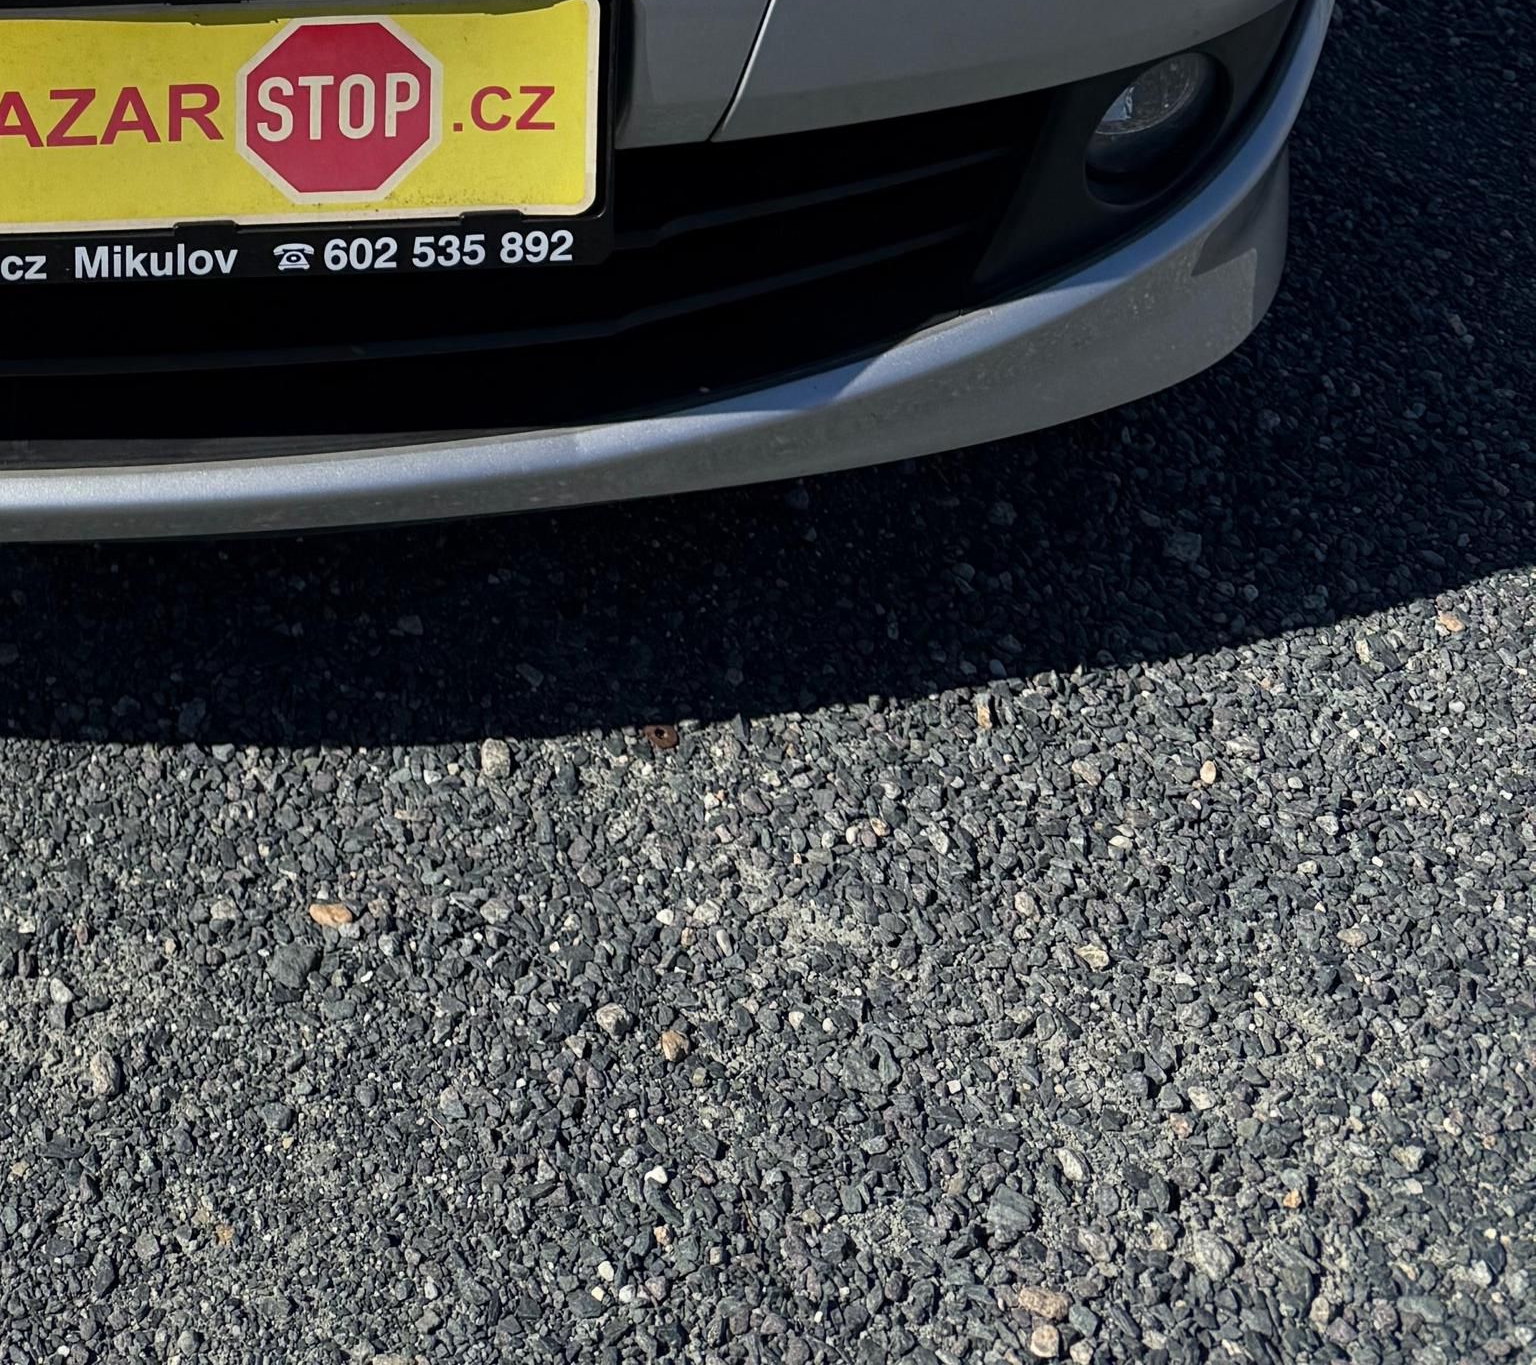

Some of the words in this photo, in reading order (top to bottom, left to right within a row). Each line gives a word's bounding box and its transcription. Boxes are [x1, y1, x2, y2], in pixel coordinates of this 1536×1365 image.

[256, 72, 421, 143] STOP
[74, 243, 238, 280] Mikulov
[323, 237, 398, 271] 602
[411, 233, 486, 267] 535
[499, 229, 575, 263] 892
